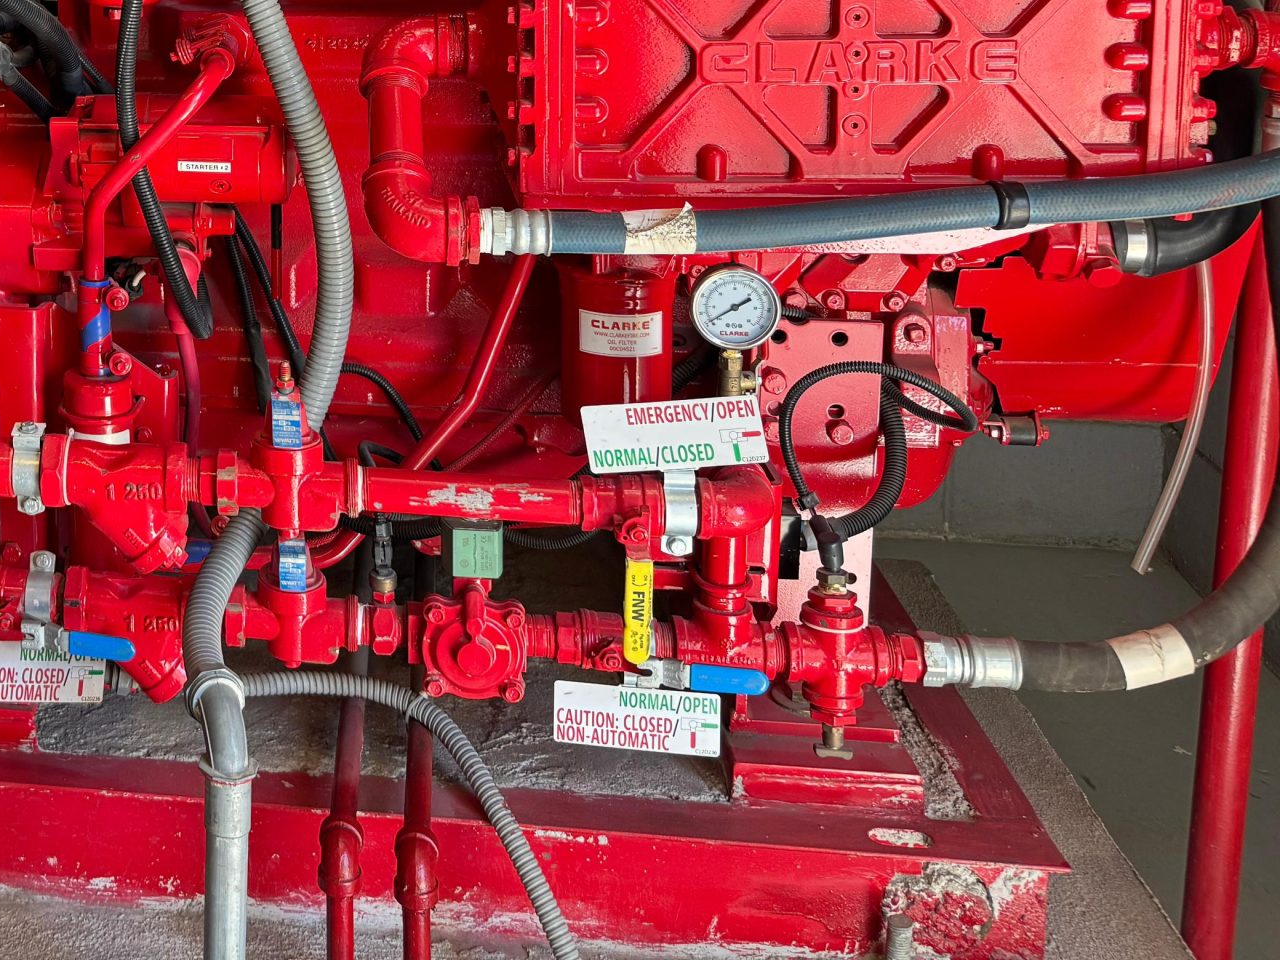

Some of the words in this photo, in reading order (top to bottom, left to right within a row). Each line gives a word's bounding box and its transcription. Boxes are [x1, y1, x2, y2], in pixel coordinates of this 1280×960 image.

[698, 39, 1019, 85] CLARKE
[381, 187, 432, 229] THAILAND
[591, 319, 650, 331] CLARKE
[625, 399, 756, 426] EMERGENCY/OPEN
[593, 443, 715, 468] NORMAL/CLOSED
[106, 483, 116, 501] 1
[632, 591, 645, 622] FNW
[22, 667, 70, 687] CLOSED/
[620, 691, 718, 715] NORMAL/OPEN
[557, 707, 619, 729] CAUTION:
[623, 714, 680, 738] CLOSED/
[556, 725, 670, 751] NON-AUTOMATIC
